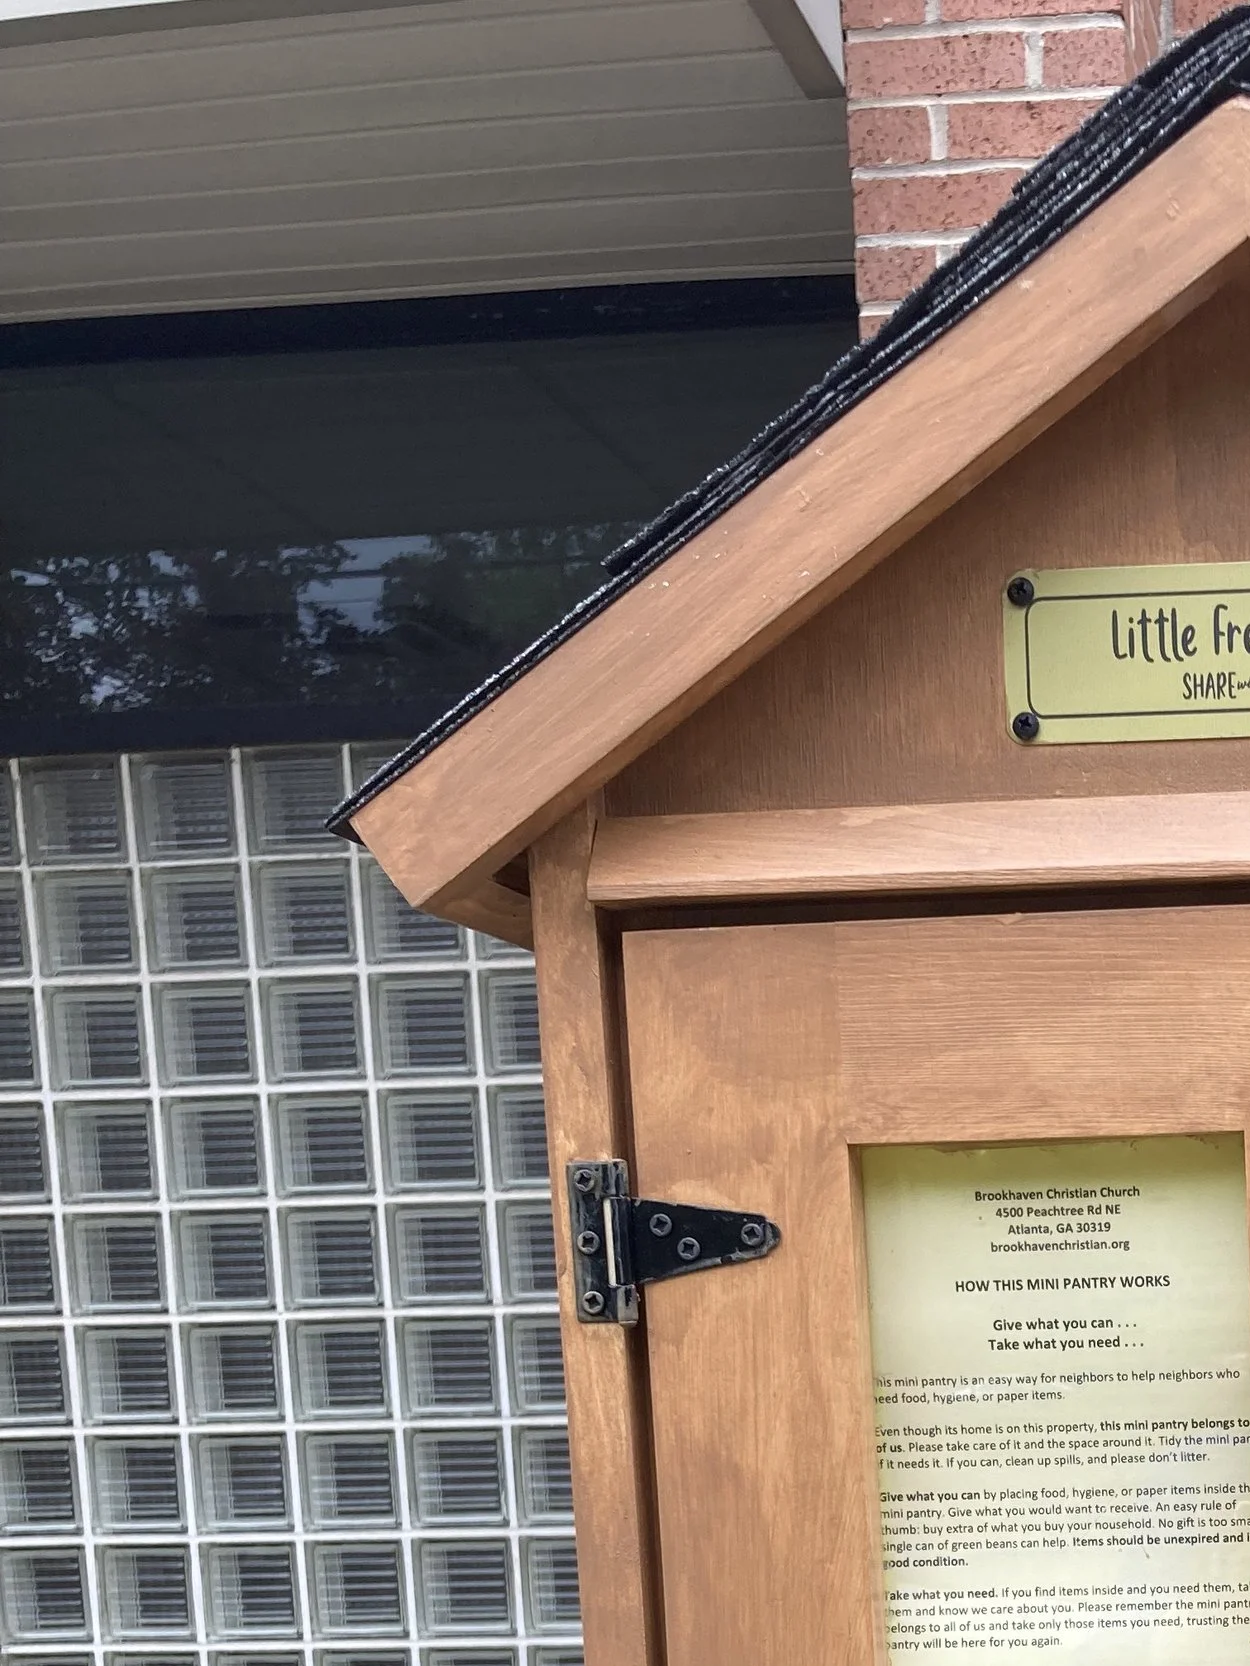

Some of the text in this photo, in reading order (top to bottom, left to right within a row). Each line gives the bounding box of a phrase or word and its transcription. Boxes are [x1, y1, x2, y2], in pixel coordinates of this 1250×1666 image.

[1112, 607, 1198, 663] Little
[1182, 671, 1236, 700] SHARE
[974, 1185, 1140, 1201] Brookhaven Christian Church
[995, 1203, 1120, 1218] 4500 Peachtree Rd NE
[1007, 1221, 1111, 1235] Atlanta, GA 30319
[990, 1239, 1130, 1252] brookhavenchristian.org
[955, 1274, 1170, 1292] HOW THIS MINI PANTRY WORKS
[992, 1317, 1113, 1332] Give what you can
[987, 1335, 1120, 1351] Take what you need
[894, 1367, 1240, 1388] mini pantry is an easy way for neighbors to help neighbors who
[879, 1491, 903, 1502] Give
[905, 1490, 935, 1501] what
[936, 1492, 958, 1503] you
[960, 1491, 980, 1500] can
[983, 1488, 996, 1501] by
[999, 1488, 1038, 1501] placing
[1040, 1486, 1069, 1499] food,
[1071, 1486, 1118, 1499] hygiene,
[1120, 1488, 1133, 1496] or
[1136, 1487, 1167, 1498] paper
[1170, 1484, 1201, 1495] items
[1203, 1482, 1235, 1494] inside
[912, 1589, 940, 1600] what
[943, 1590, 964, 1601] you
[967, 1587, 998, 1598] need.
[1001, 1586, 1009, 1597] If
[1011, 1589, 1031, 1599] you
[1034, 1585, 1055, 1597] find
[1059, 1586, 1088, 1596] items
[1092, 1584, 1123, 1595] inside
[1126, 1583, 1146, 1594] and
[1149, 1585, 1169, 1596] you
[1172, 1582, 1199, 1593] need
[1202, 1582, 1234, 1593] them,
